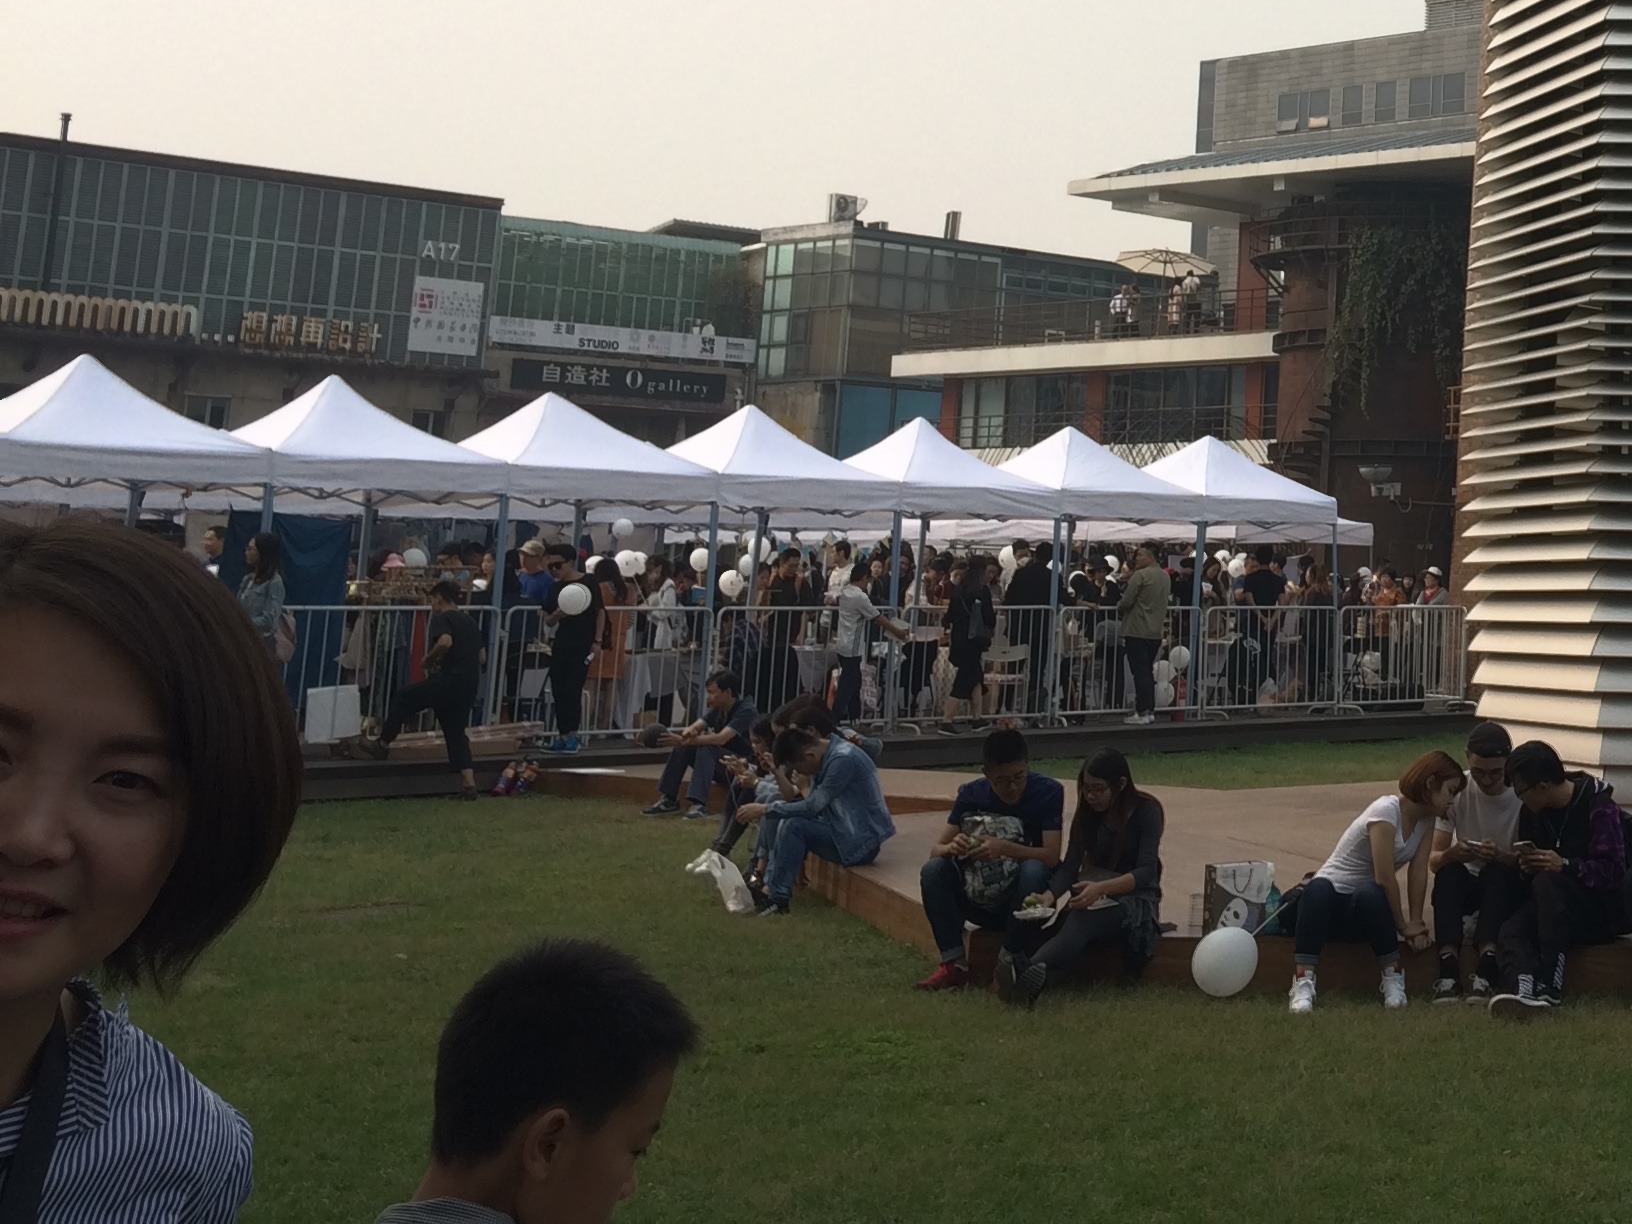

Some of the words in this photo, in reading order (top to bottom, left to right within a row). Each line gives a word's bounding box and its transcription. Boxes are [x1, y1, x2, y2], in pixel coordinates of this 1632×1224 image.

[421, 240, 461, 262] A17
[577, 337, 620, 351] STUDIO
[541, 363, 611, 387] 自造社
[647, 378, 710, 399] gallery
